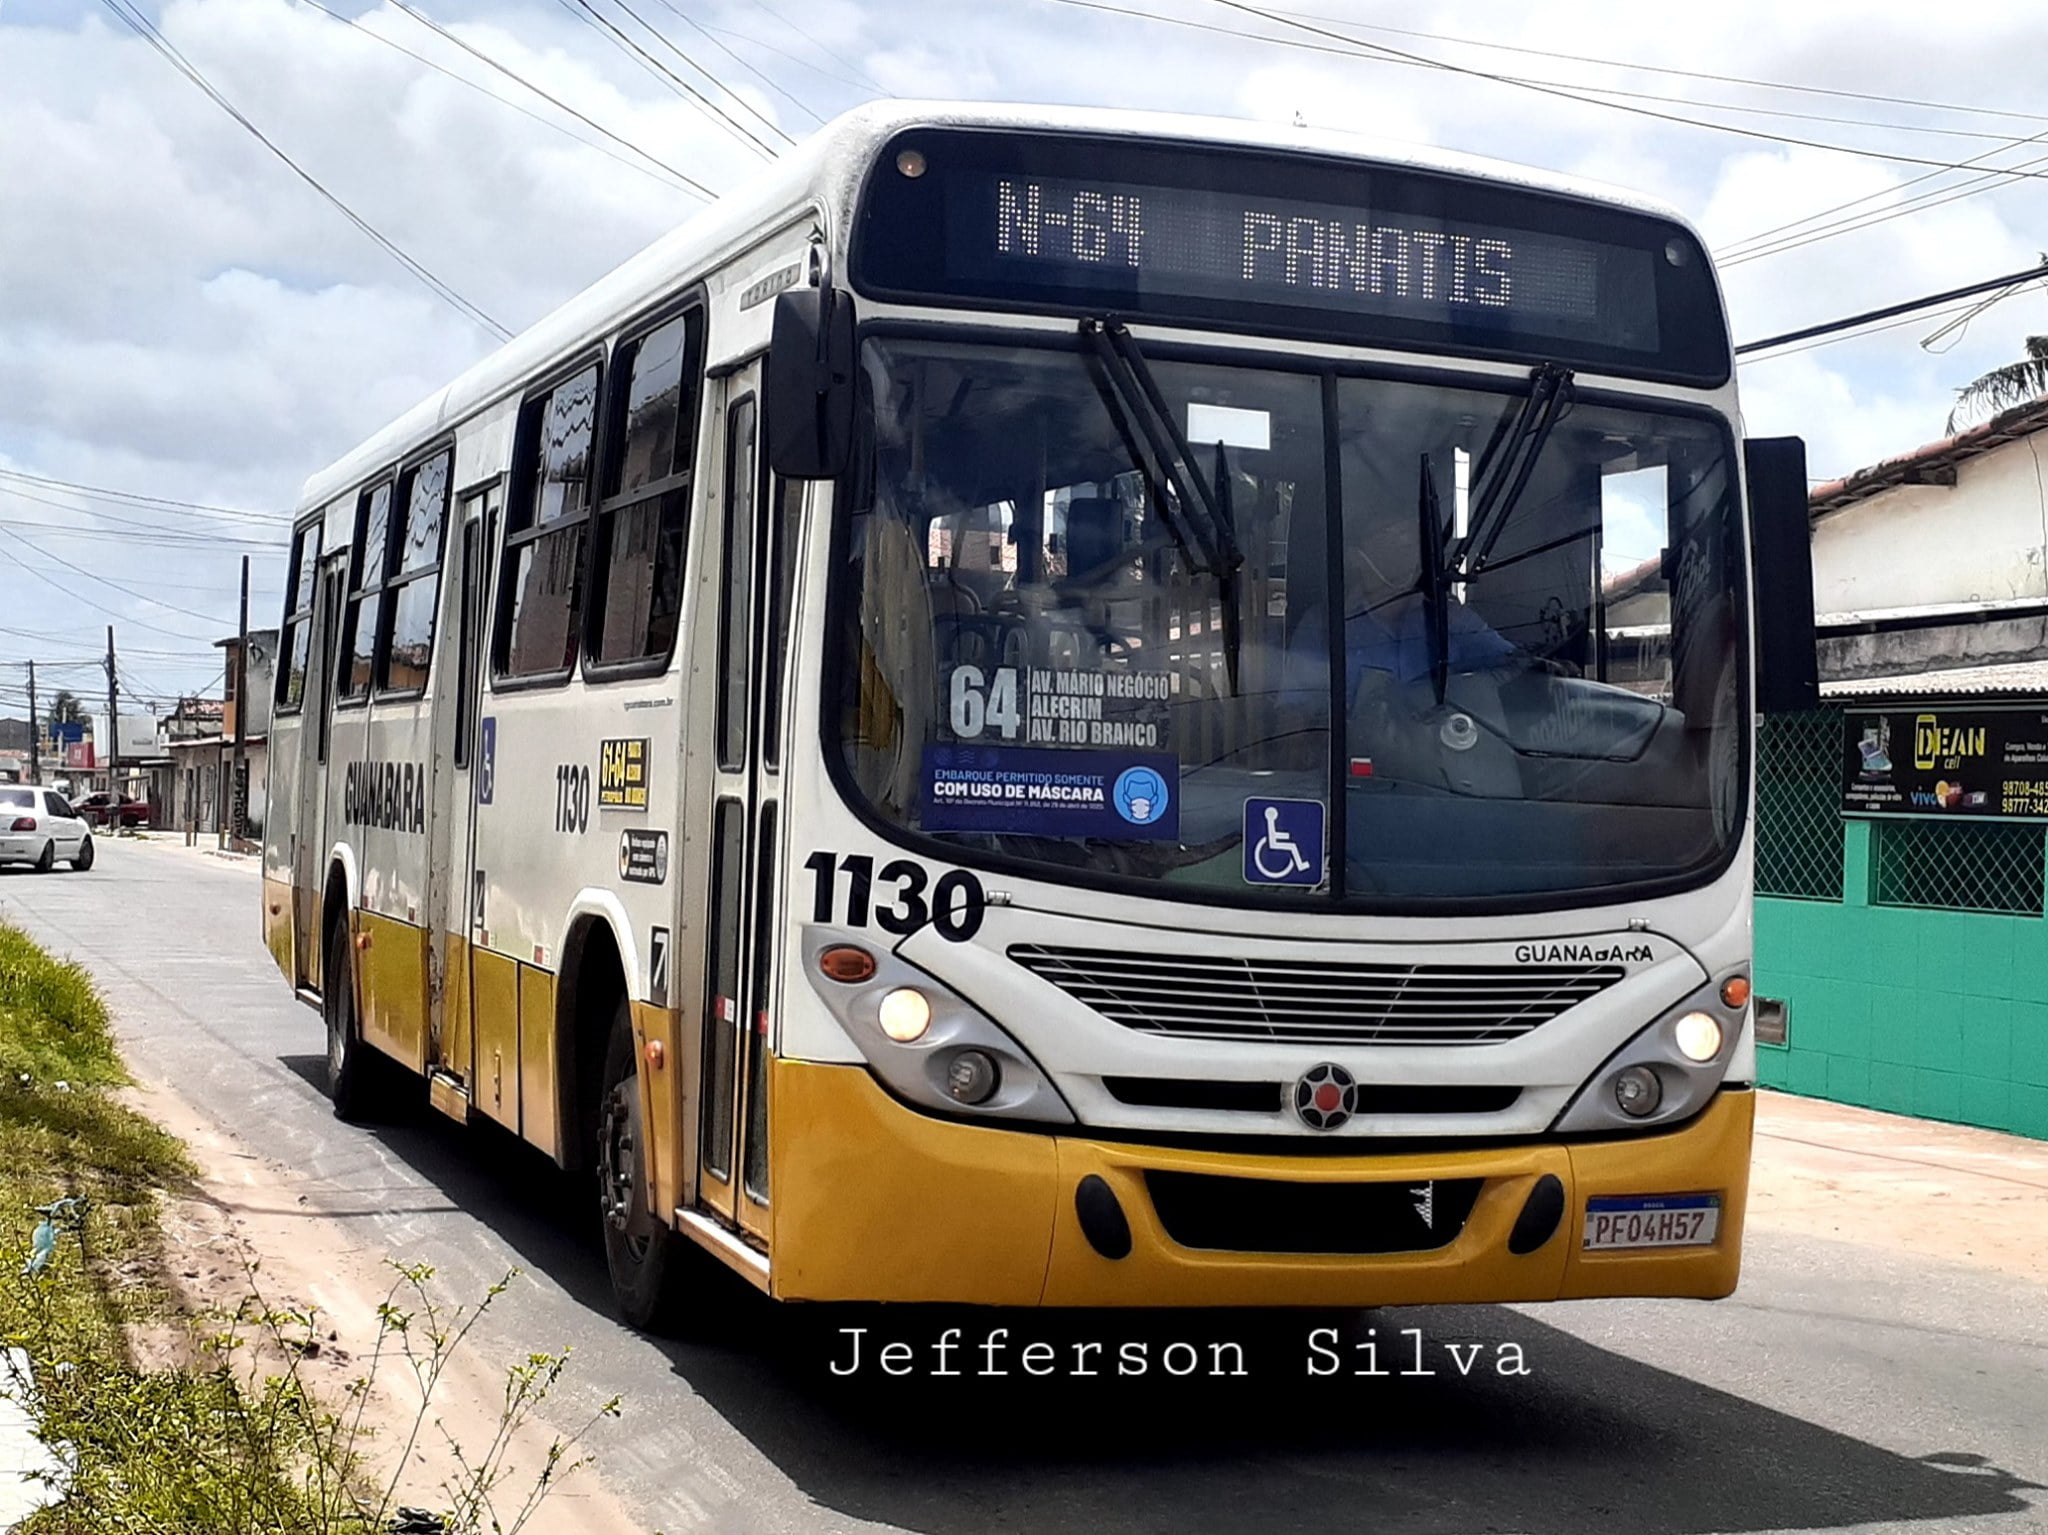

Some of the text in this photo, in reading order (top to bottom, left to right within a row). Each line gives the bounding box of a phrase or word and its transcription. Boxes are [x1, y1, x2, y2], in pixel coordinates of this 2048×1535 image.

[998, 180, 1512, 307] N-64 PANATIS
[747, 269, 792, 305] TORINO
[950, 664, 1021, 738] 64
[1031, 668, 1169, 700] AV. MÁRIO NEGÓCIO
[1031, 694, 1102, 720] ALECRIM
[1031, 718, 1157, 747] AV. RIO BRANCO
[1916, 727, 1986, 756] DEAN
[933, 782, 1105, 802] COM USO DE MÁSCARA
[934, 769, 1105, 786] EMBARQUE PERMITIDO SOMENTE
[344, 761, 425, 834] GUANABARA
[555, 764, 590, 834] 1130
[804, 851, 985, 943] 1130
